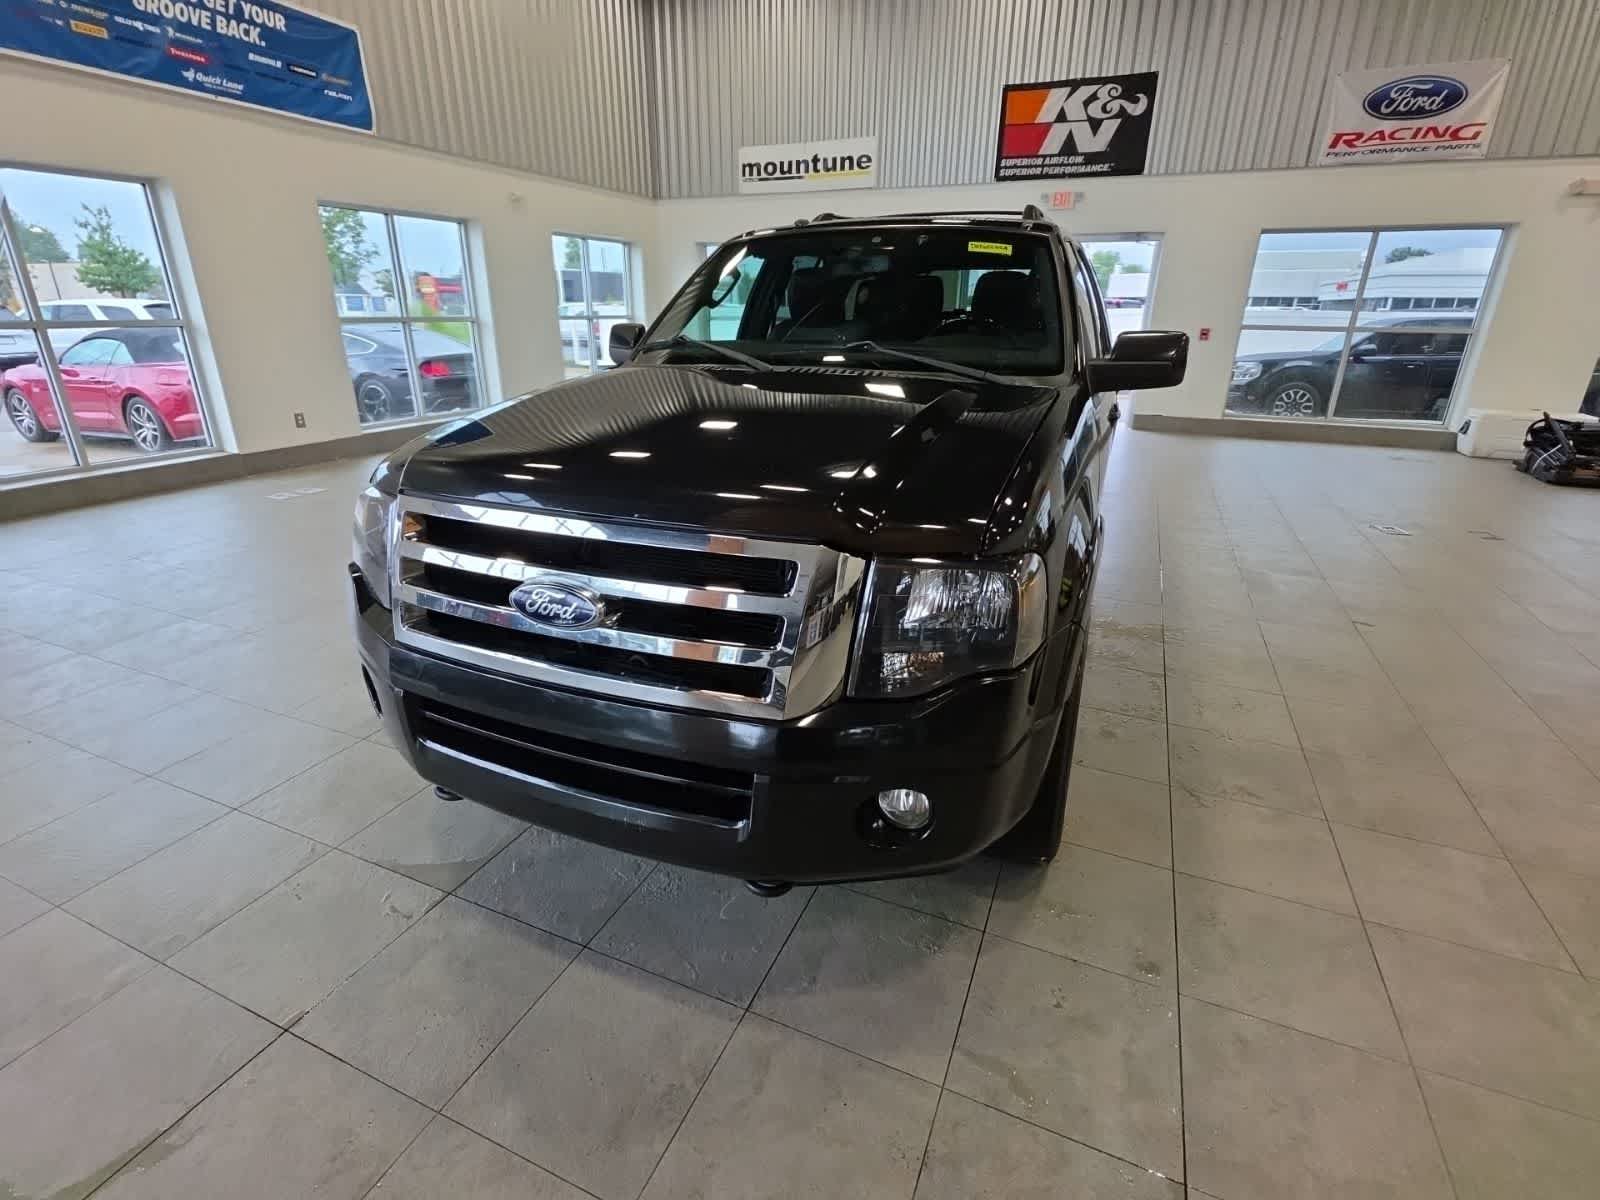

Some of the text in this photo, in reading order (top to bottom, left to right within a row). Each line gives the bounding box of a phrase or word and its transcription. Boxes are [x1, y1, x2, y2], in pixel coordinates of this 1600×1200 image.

[132, 0, 212, 31] GROOVE
[215, 14, 266, 47] BACK.
[240, 1, 287, 32] YOUR
[196, 71, 221, 86] Quick
[1380, 82, 1449, 114] Ford
[1328, 122, 1488, 149] RACING
[1000, 157, 1043, 167] SUPERIOR
[1326, 143, 1481, 158] PERFORMANCE PARTS
[742, 153, 873, 178] mountune
[999, 166, 1043, 177] SUPERIOR
[1053, 191, 1074, 208] EXIT
[525, 588, 577, 619] Ford
